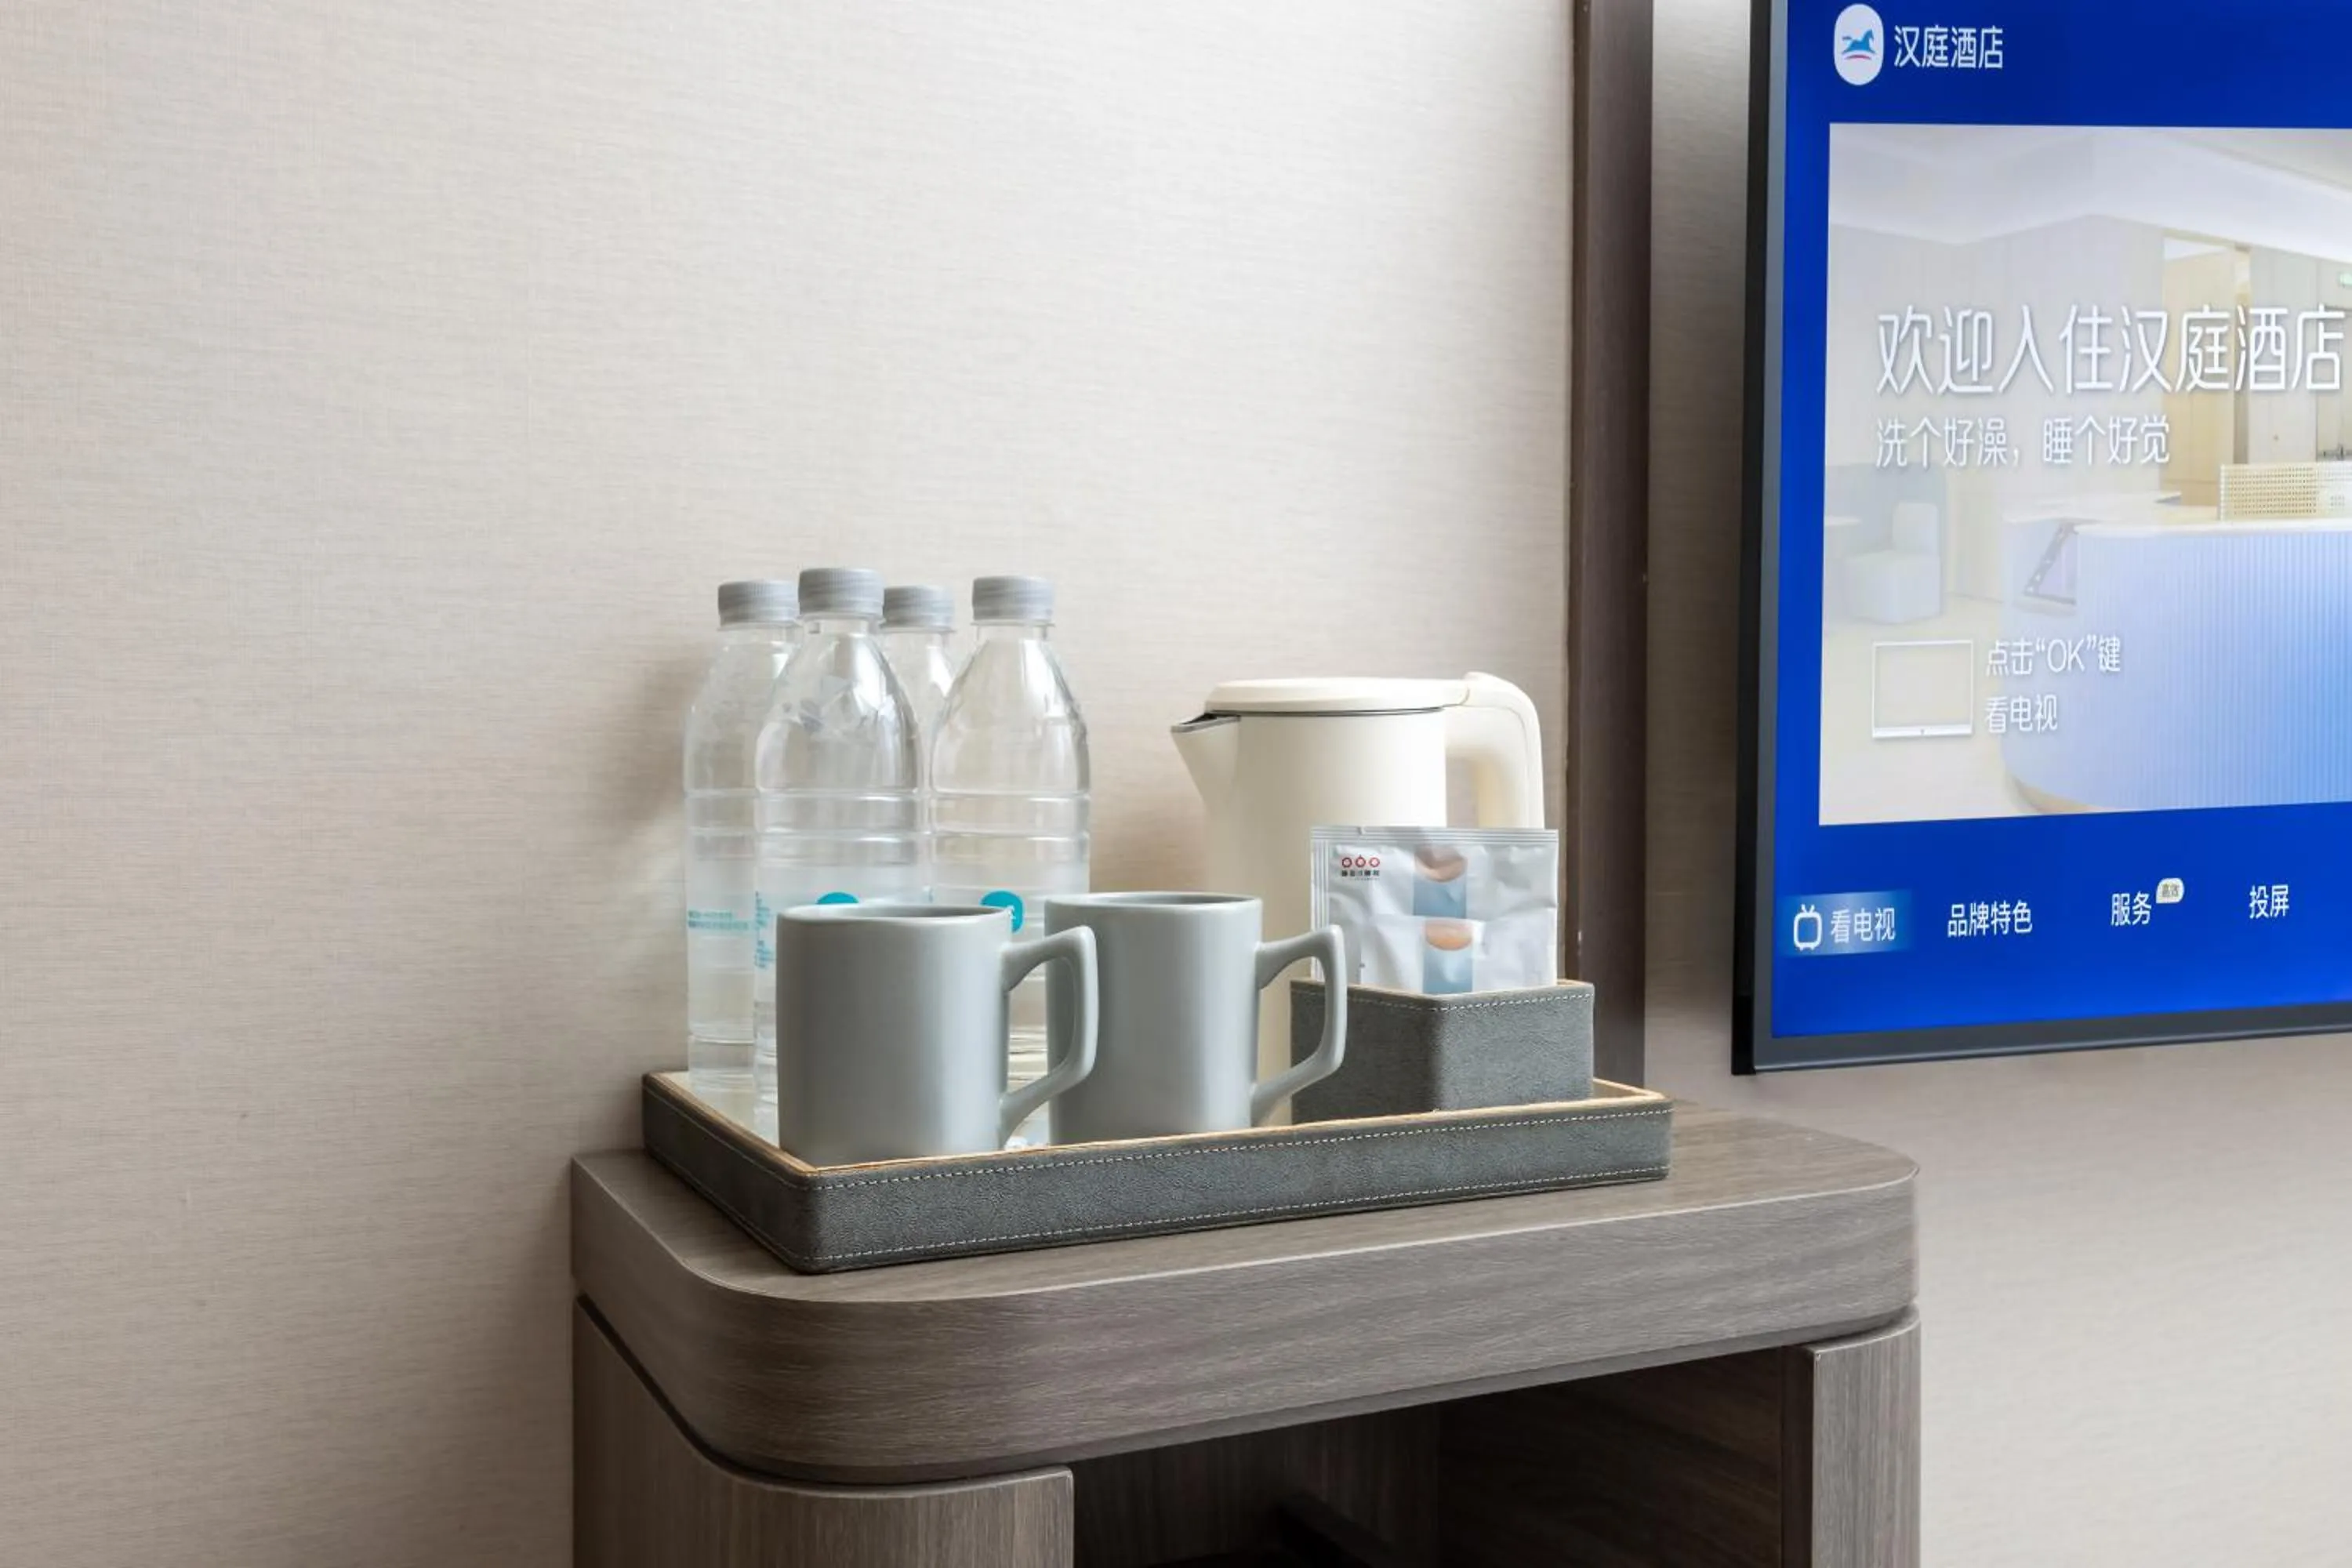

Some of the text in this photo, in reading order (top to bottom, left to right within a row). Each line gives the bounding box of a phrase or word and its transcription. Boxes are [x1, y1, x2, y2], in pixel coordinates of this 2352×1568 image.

[1894, 24, 2003, 68] 汉庭酒店
[1877, 304, 2345, 393] 欢迎入住汉庭酒店
[1984, 695, 2058, 734] 看电视
[1947, 899, 2033, 938] 品牌特色
[2111, 891, 2152, 926] 服务
[2249, 884, 2289, 919] 投屏
[1831, 906, 1896, 944] 看电视
